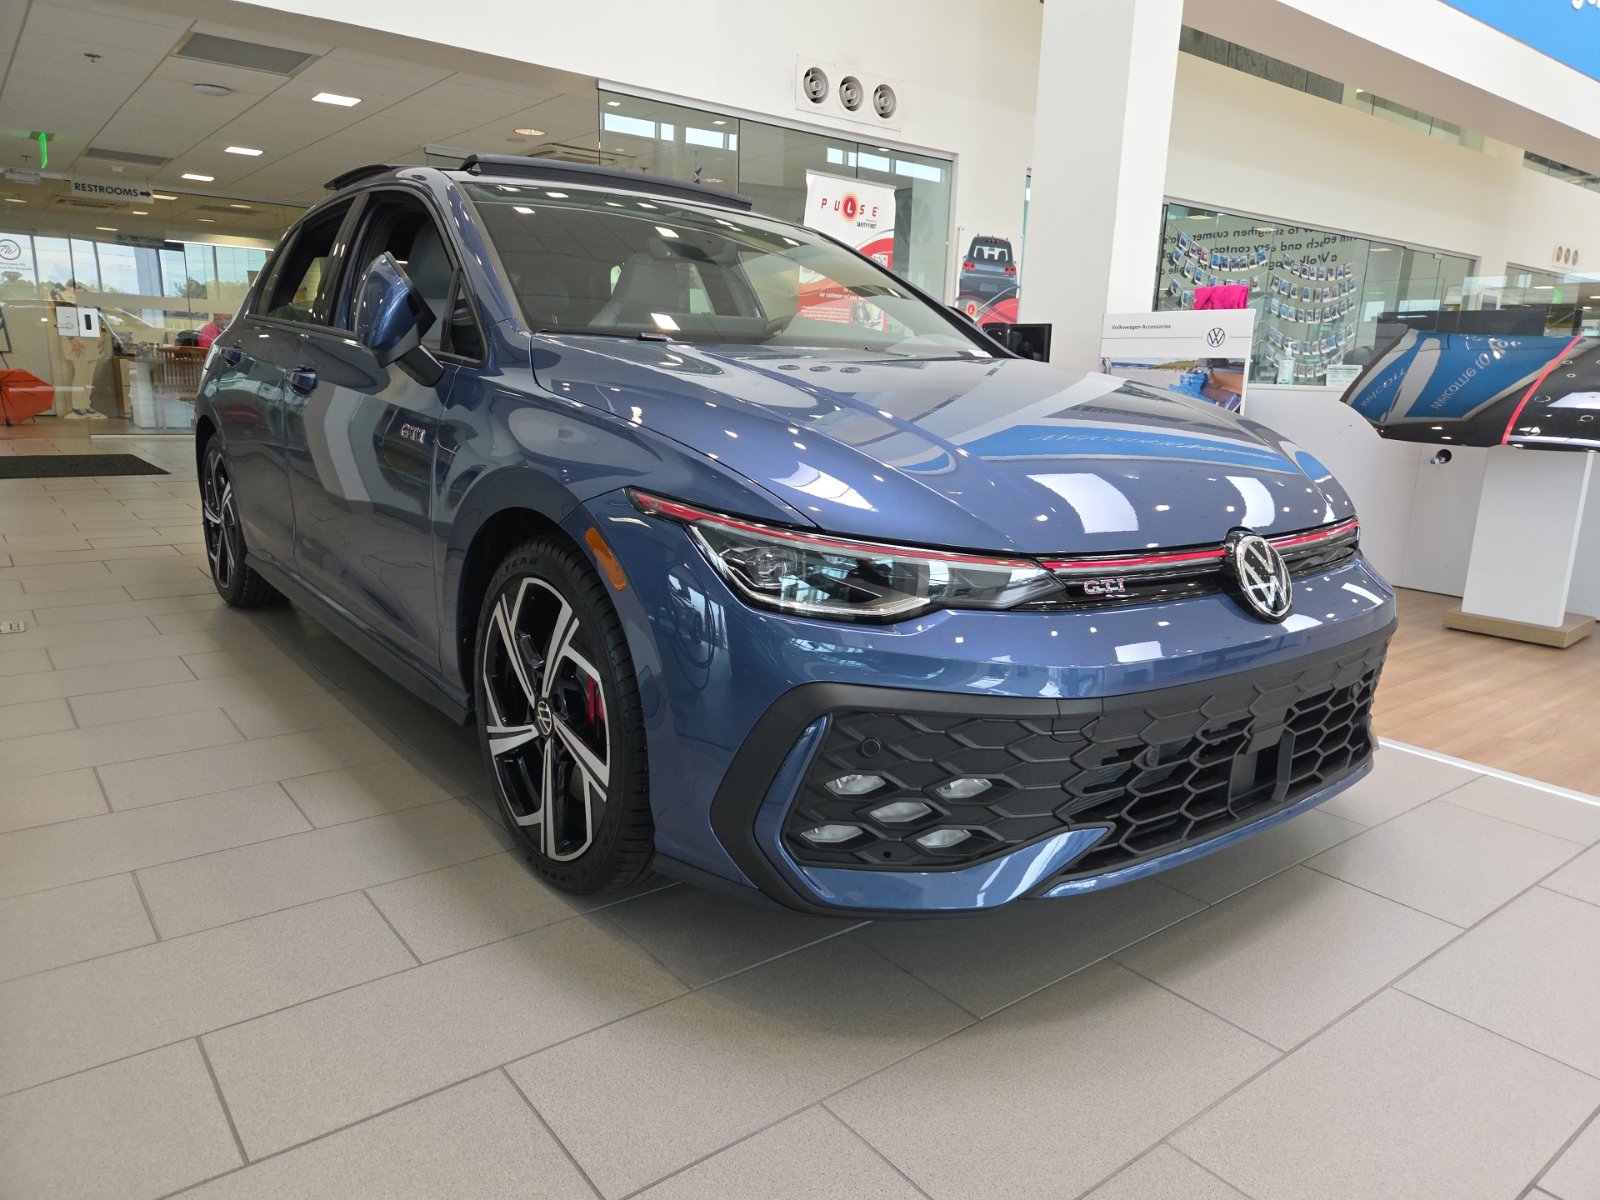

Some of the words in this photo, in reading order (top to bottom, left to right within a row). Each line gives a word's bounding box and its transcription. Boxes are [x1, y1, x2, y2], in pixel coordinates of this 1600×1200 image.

[74, 182, 138, 197] RESTROOMS
[821, 197, 878, 217] PULSE
[1111, 323, 1142, 331] Volkswagen
[401, 423, 426, 444] GTI
[1084, 577, 1125, 595] GTI
